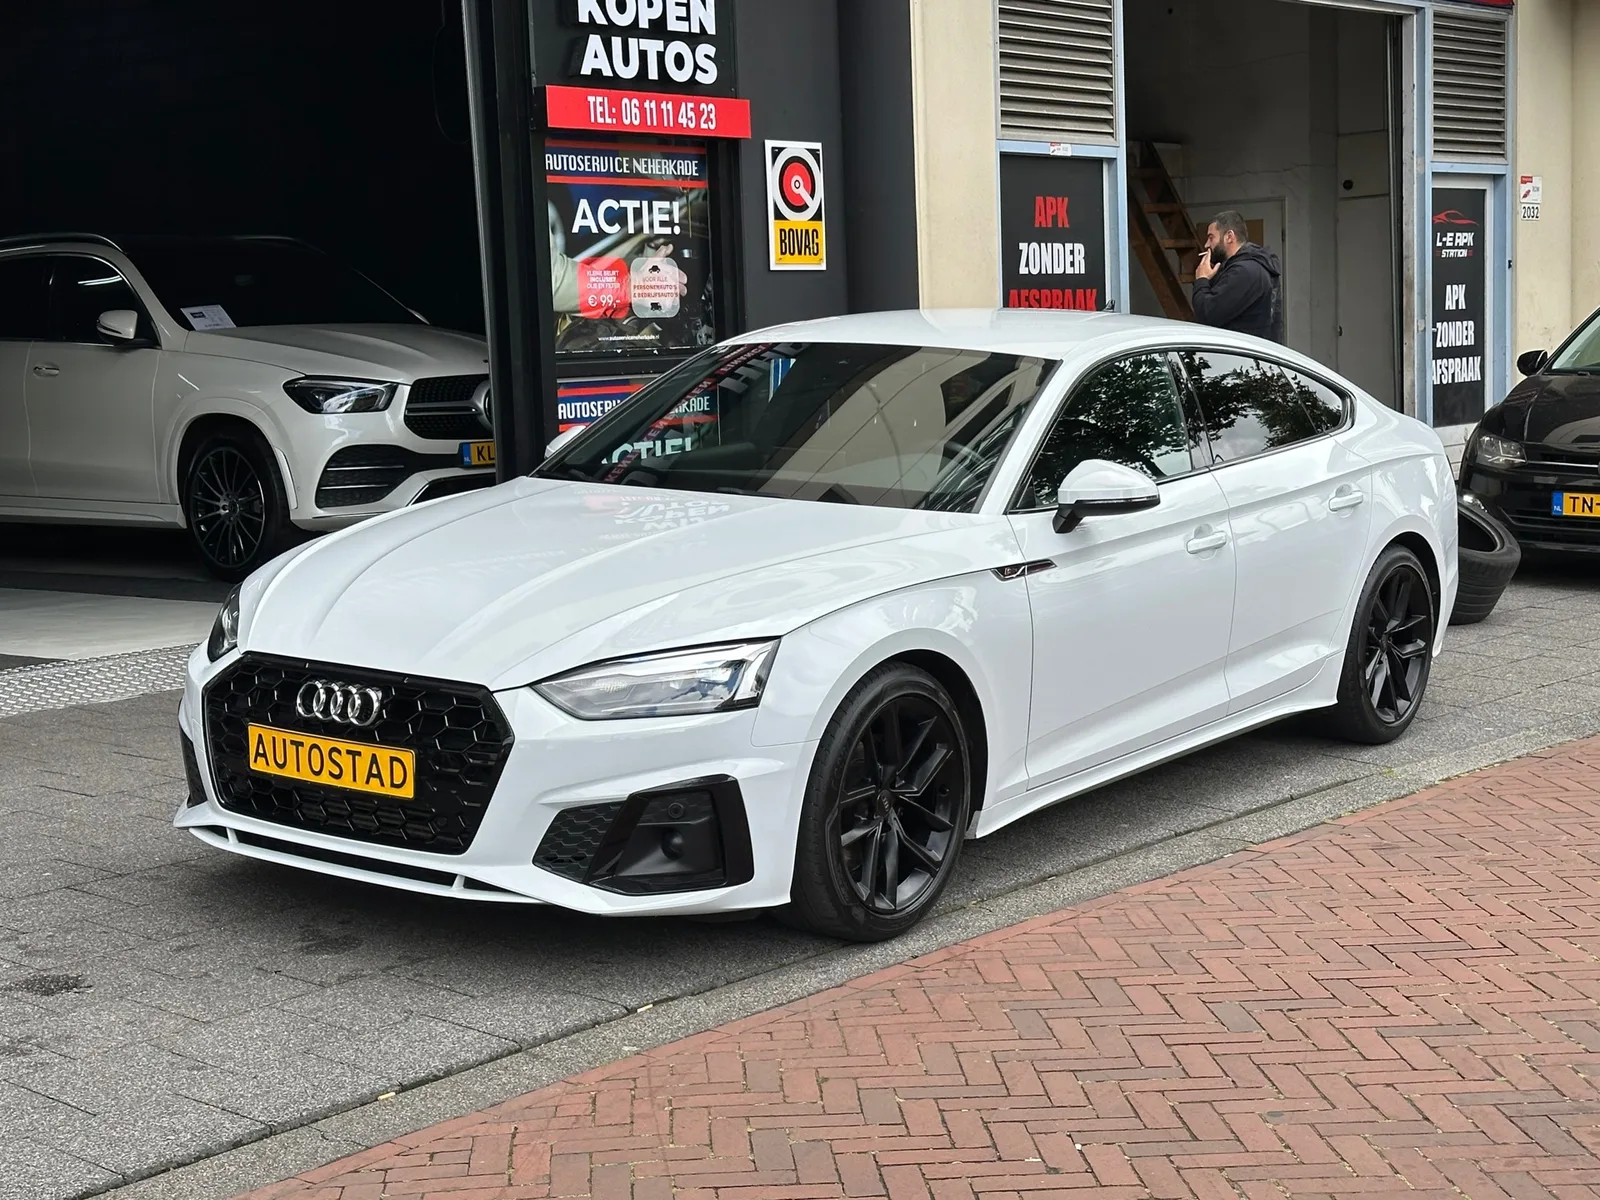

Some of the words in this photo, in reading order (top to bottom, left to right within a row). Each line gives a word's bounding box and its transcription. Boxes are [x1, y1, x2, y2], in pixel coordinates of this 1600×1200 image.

[577, 0, 716, 35] KOPEN
[580, 34, 718, 85] AUTOS
[587, 96, 616, 125] TEL:
[621, 99, 640, 126] 06
[644, 100, 657, 127] 11
[661, 101, 674, 128] 11
[678, 102, 695, 129] 45
[699, 103, 716, 130] 23
[545, 153, 630, 174] AUTOSERVICE
[632, 157, 699, 177] NEHERKADE
[571, 198, 681, 235] ACTIE!
[1034, 196, 1070, 228] APK
[1522, 206, 1539, 219] 2032
[779, 227, 820, 257] BOVAG
[1436, 232, 1454, 247] L-E
[1455, 232, 1475, 247] APK
[1441, 249, 1468, 258] STATION
[1018, 242, 1085, 275] ZONDER
[588, 295, 598, 307] €
[600, 294, 621, 308] 99,-
[1009, 288, 1097, 311] AFSPRAAK
[1445, 284, 1466, 310] APK
[1436, 320, 1475, 348] ZONDER
[1432, 356, 1481, 385] AFSPRAAK
[477, 445, 495, 462] KL
[253, 733, 408, 789] AUTOSTAD
